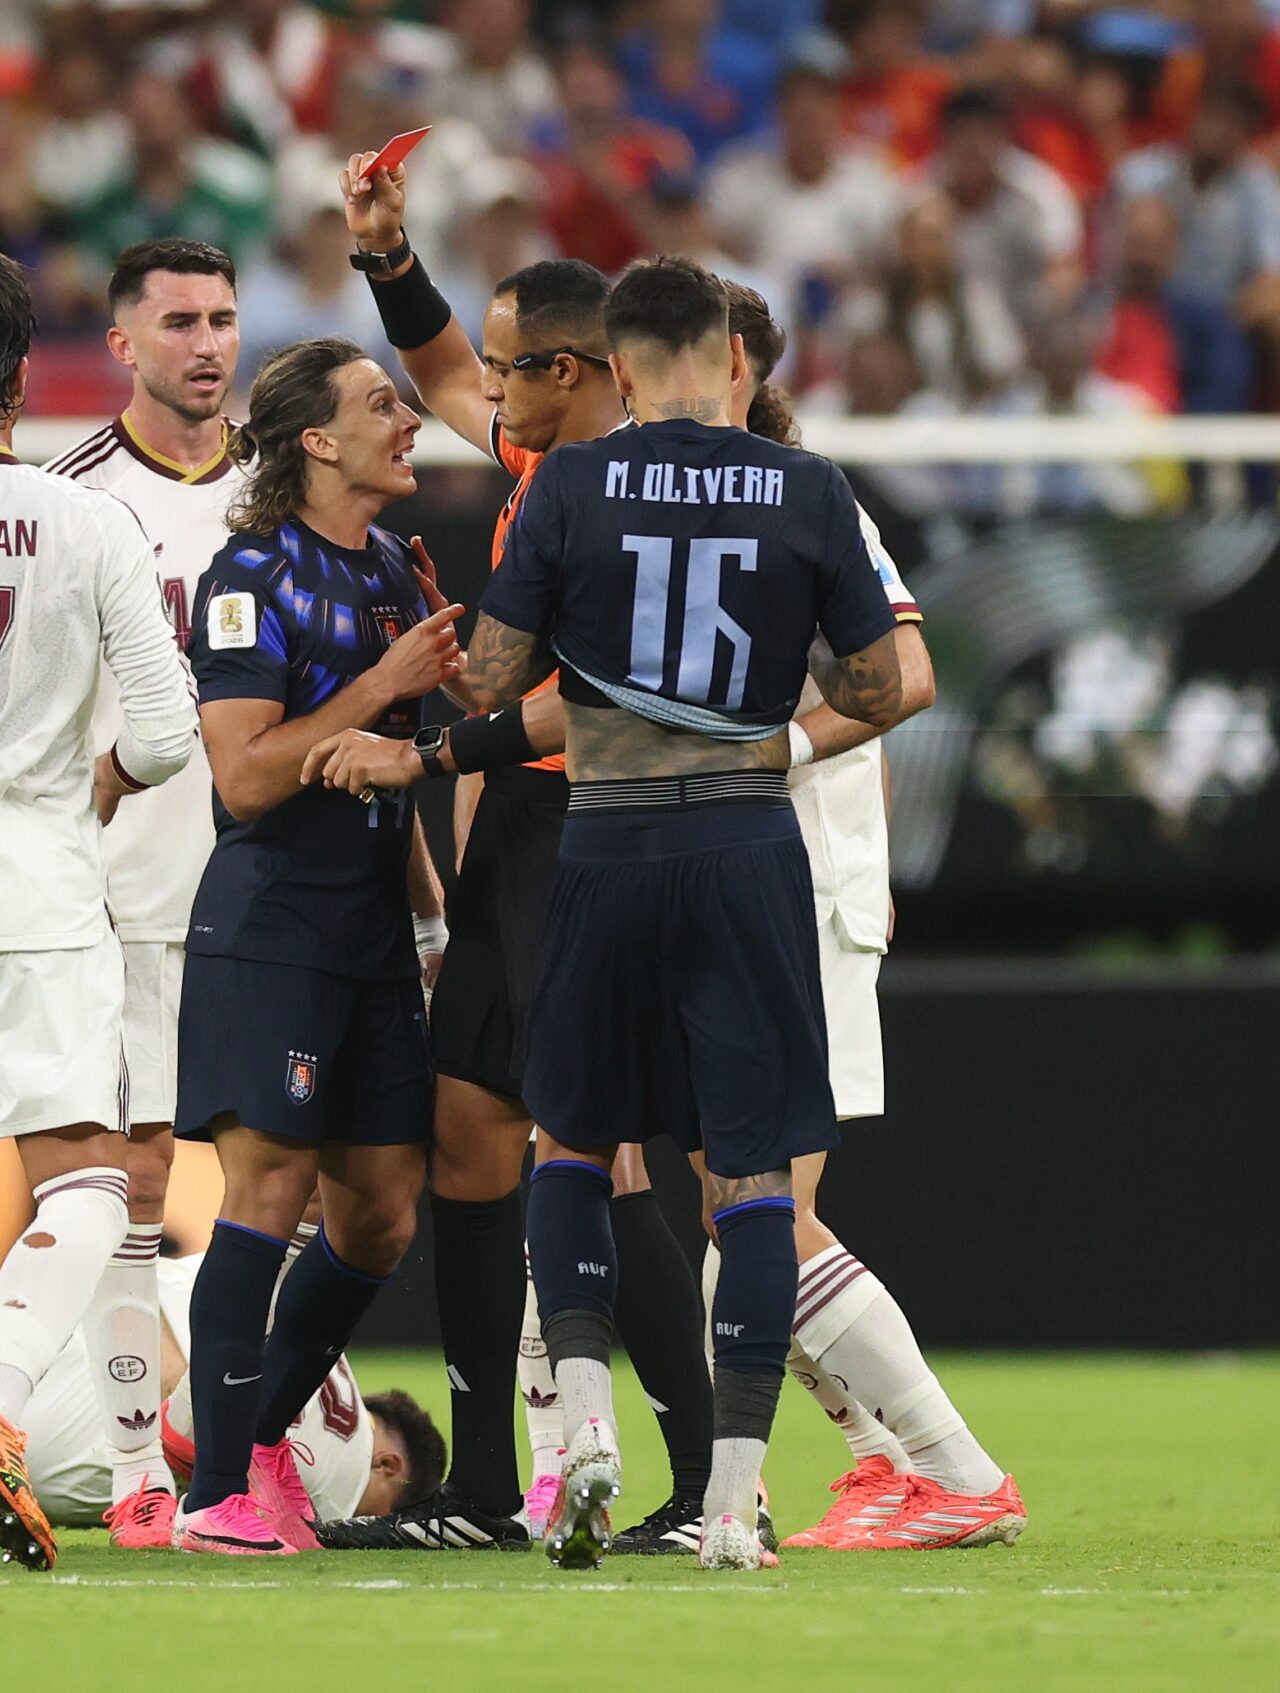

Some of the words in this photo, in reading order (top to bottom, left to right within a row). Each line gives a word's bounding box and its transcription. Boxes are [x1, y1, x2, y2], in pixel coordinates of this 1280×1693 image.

[605, 461, 637, 499] M.
[642, 463, 784, 506] OLIVERA
[622, 534, 758, 711] 16
[577, 1261, 609, 1278] AUF
[715, 1321, 746, 1338] AUF
